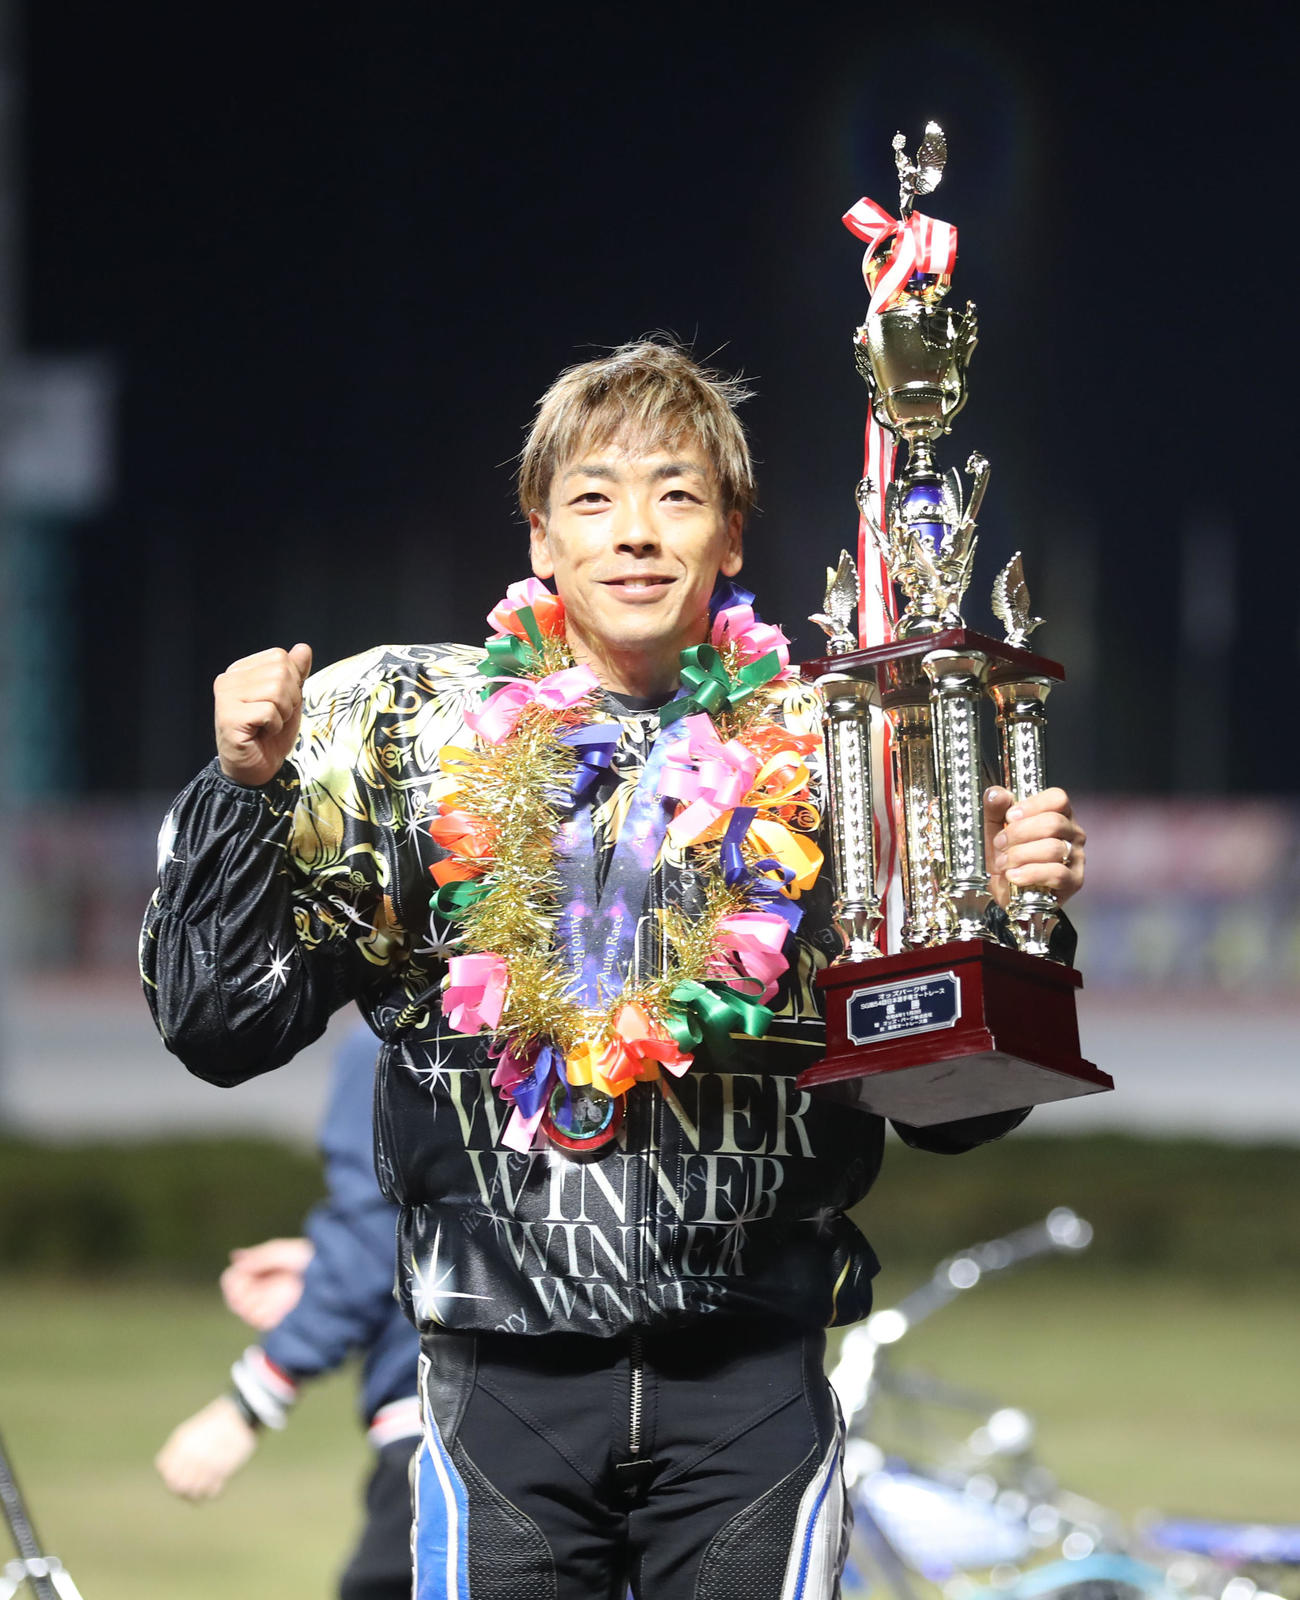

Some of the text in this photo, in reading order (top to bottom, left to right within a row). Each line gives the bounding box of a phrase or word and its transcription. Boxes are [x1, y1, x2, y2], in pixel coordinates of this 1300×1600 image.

[570, 914, 585, 977] Auto Rac
[606, 914, 624, 946] Race
[597, 949, 616, 982] Auto
[447, 1066, 817, 1159] WNER
[464, 1149, 785, 1224] WINNER
[502, 1221, 746, 1282] WINNER
